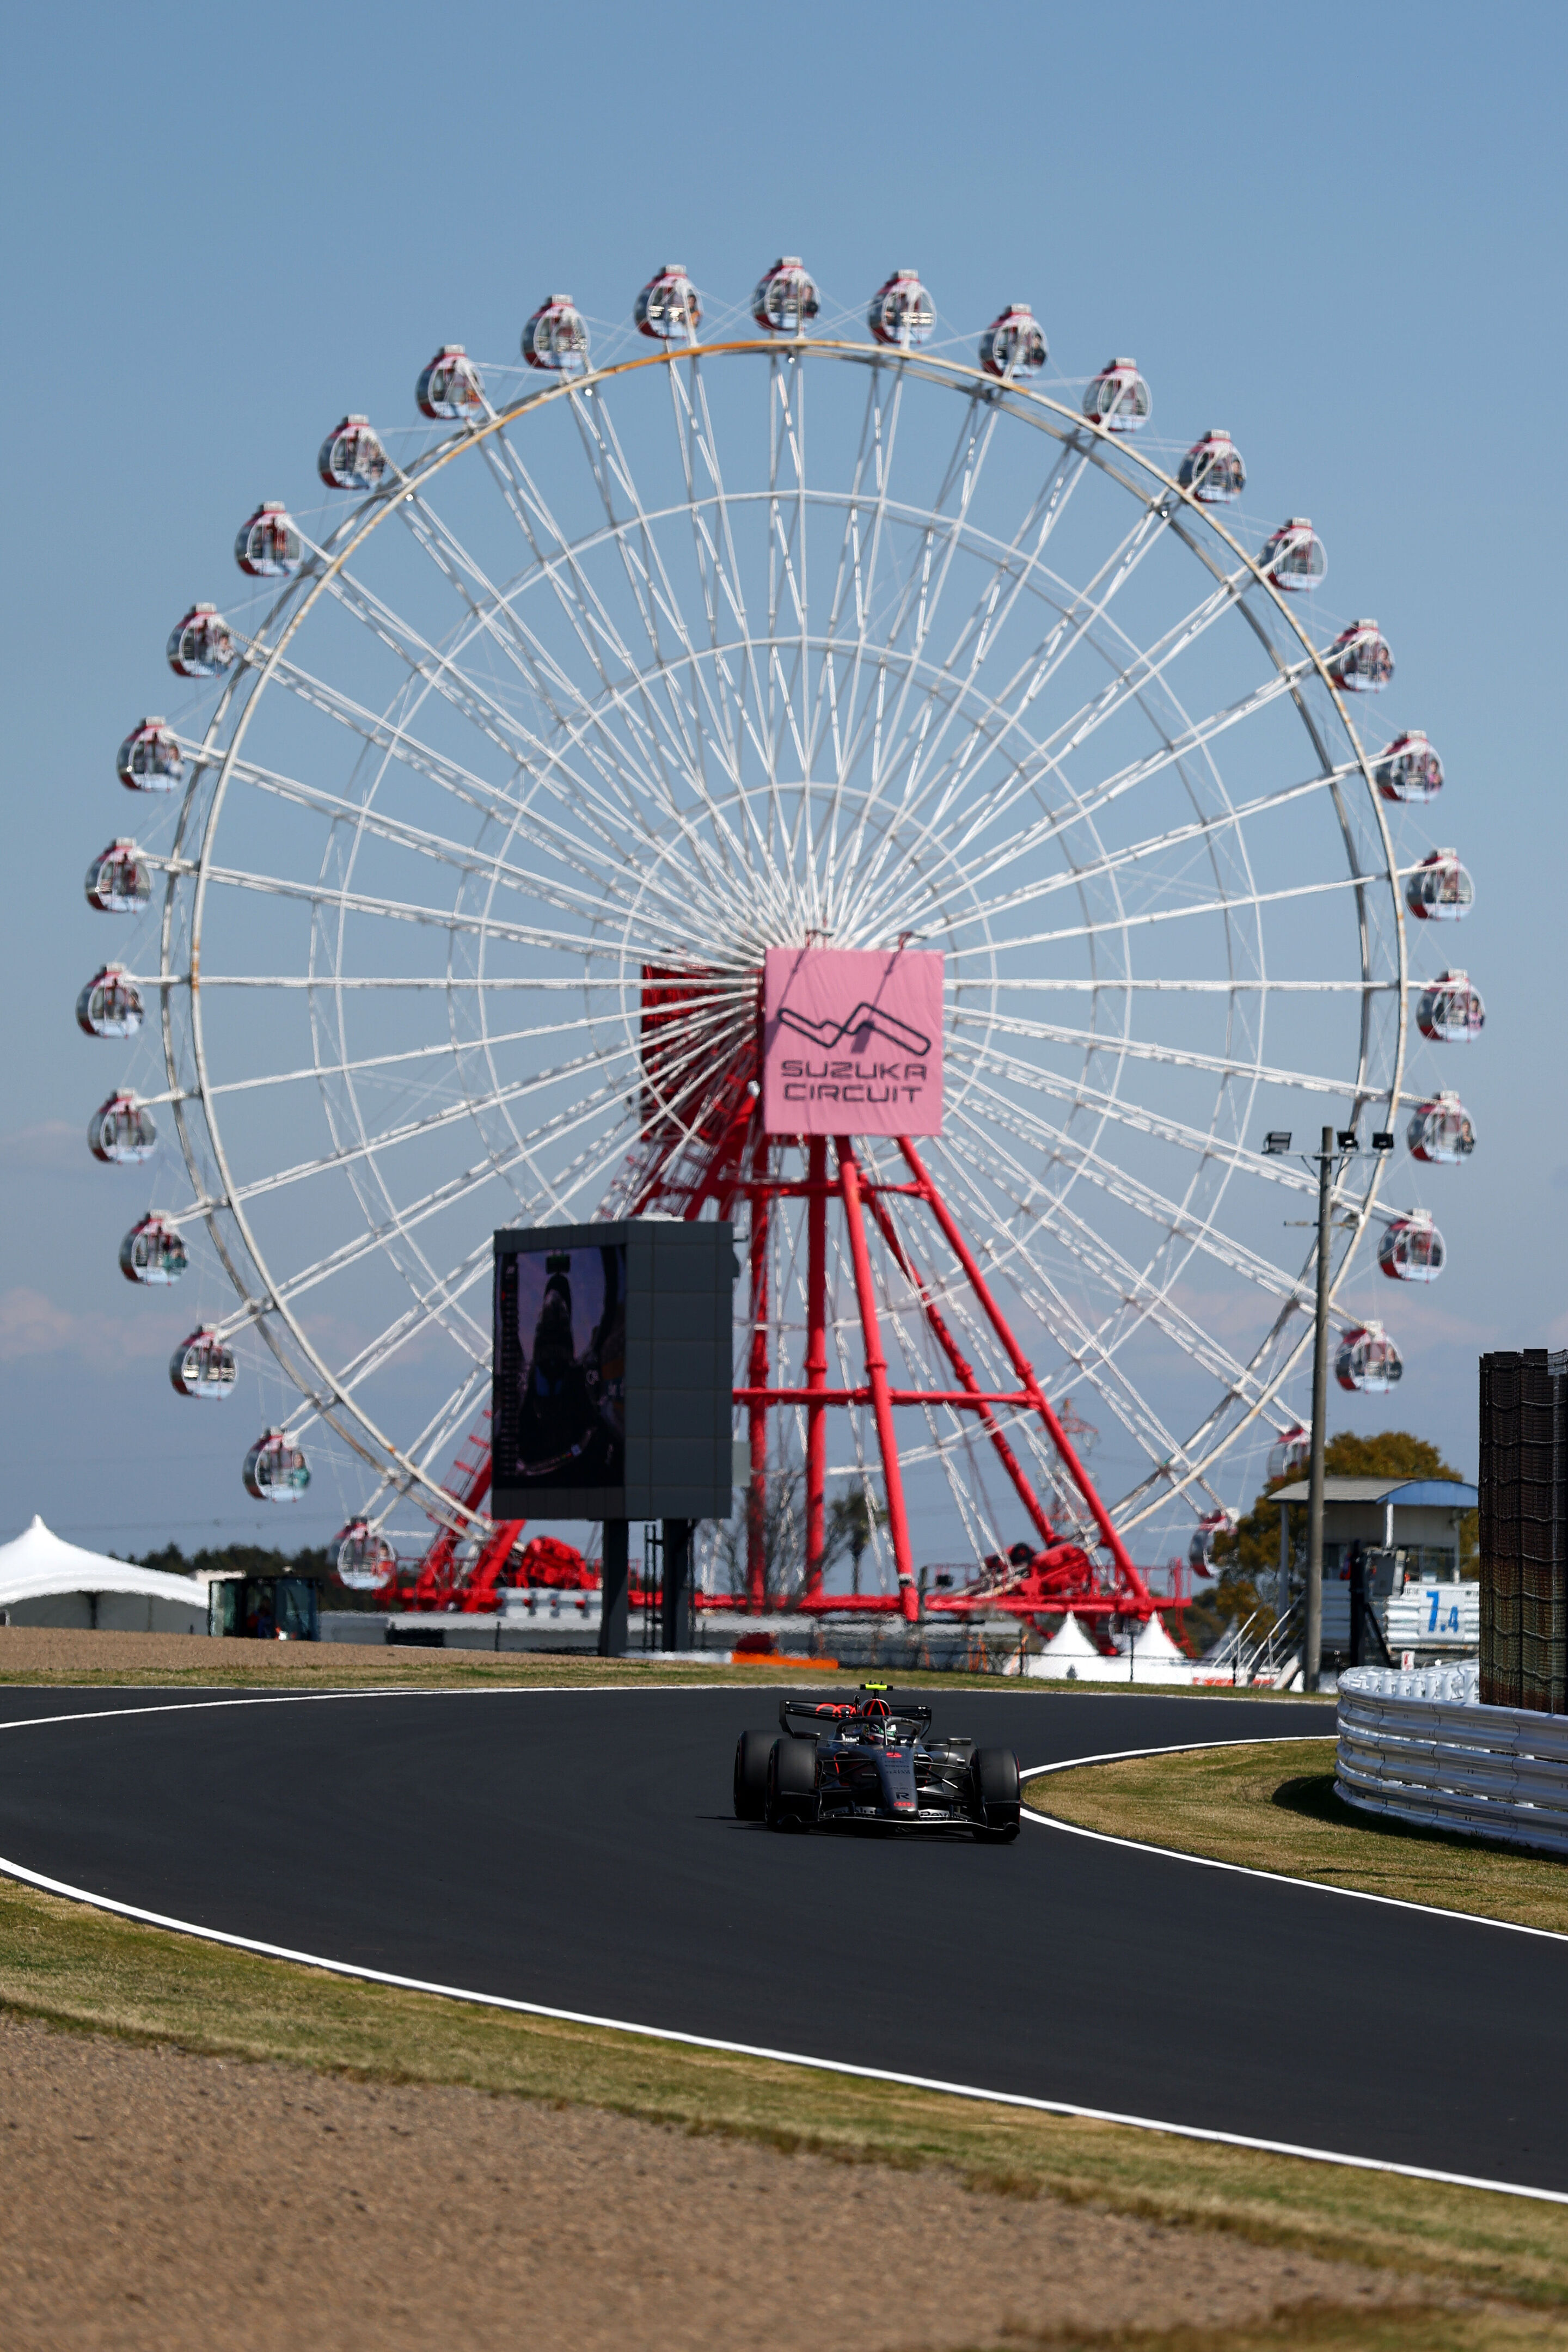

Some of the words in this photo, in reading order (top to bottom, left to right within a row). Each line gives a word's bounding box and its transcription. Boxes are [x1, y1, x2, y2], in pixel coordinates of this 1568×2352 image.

[781, 1059, 927, 1081] SUZUKA
[783, 1083, 922, 1104] CIRCUIT
[1426, 1591, 1459, 1633] 7.4
